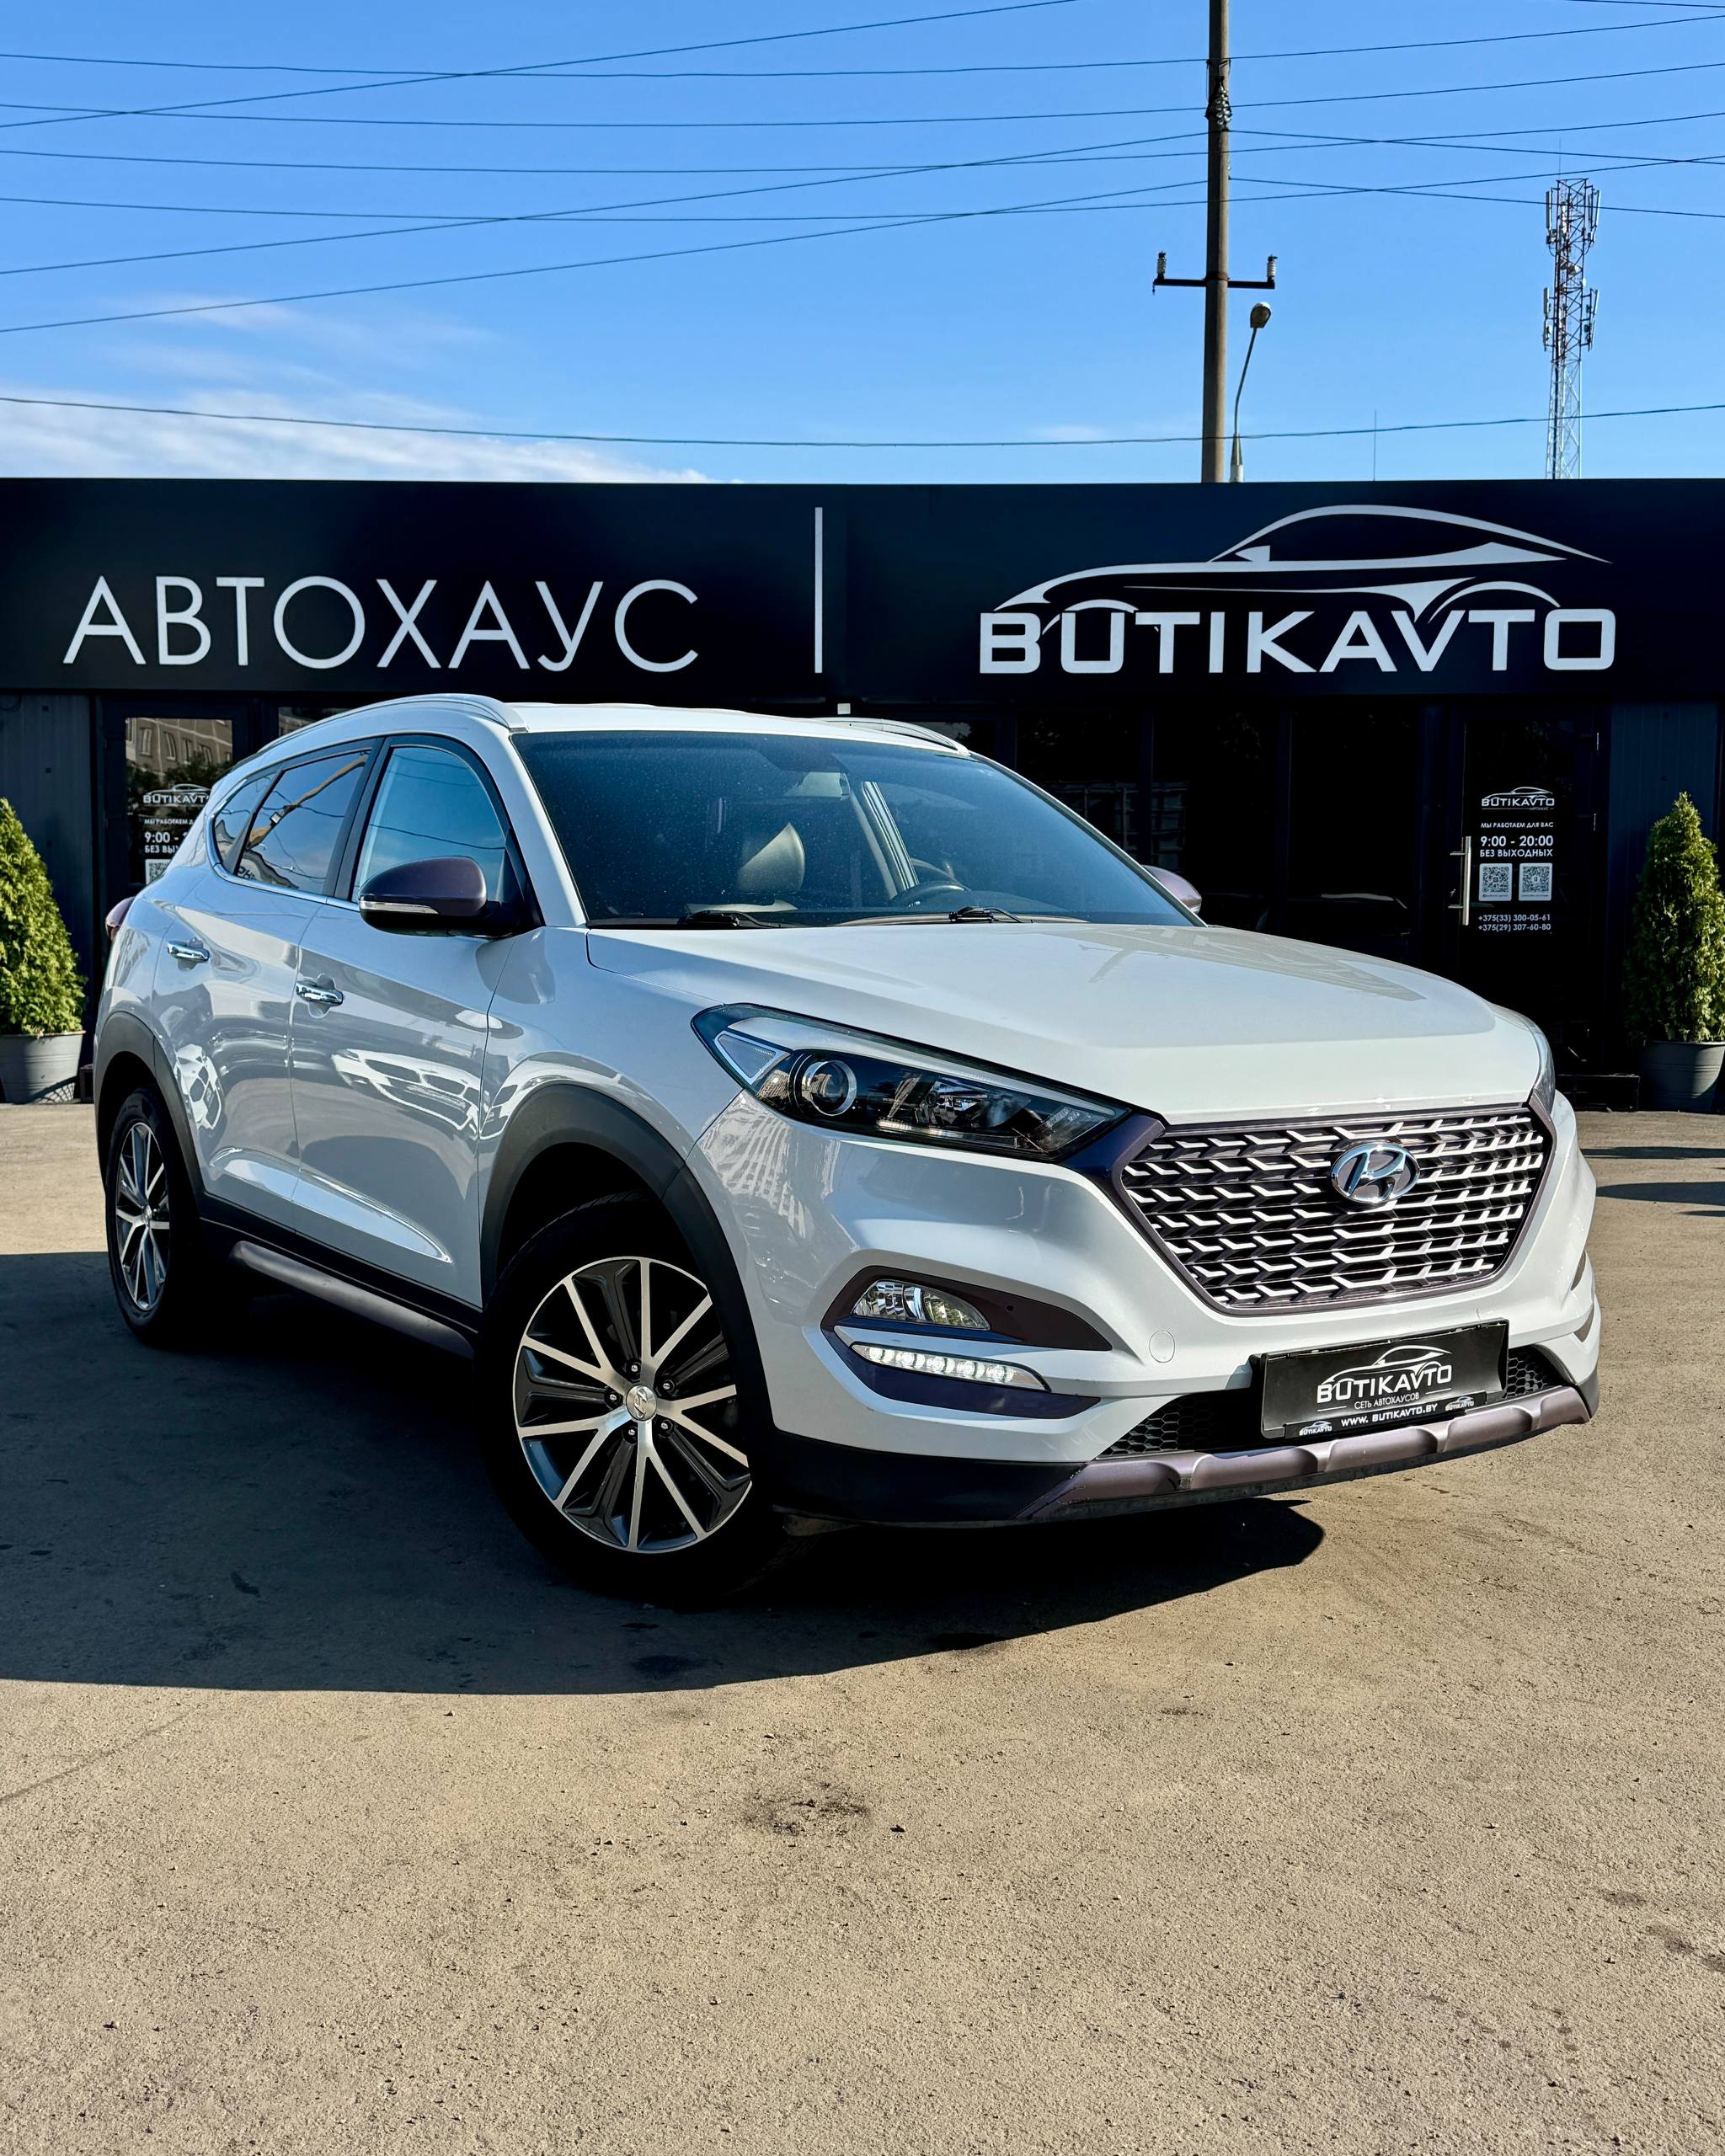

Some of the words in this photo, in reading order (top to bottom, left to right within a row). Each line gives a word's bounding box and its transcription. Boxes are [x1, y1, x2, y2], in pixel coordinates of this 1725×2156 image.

[62, 574, 700, 673] АВТОХАУС
[978, 607, 1616, 674] BUTIKAVTO
[142, 794, 209, 803] BUTIKAVT
[1482, 798, 1555, 807] BUTIKAVTO
[144, 831, 170, 843] 9:00
[1480, 835, 1507, 847] 9:00
[1519, 835, 1554, 846] 20:00
[144, 845, 160, 854] БЕЗ
[1480, 849, 1495, 857] БЕЗ
[1498, 848, 1553, 858] ВЫХОДНЫХ
[1478, 914, 1512, 923] +375(33)
[1478, 924, 1512, 932] +375(29)
[1513, 923, 1551, 931] 307-60-80
[1316, 1364, 1452, 1404] BUTIKAVTO
[1354, 1400, 1372, 1410] СЕТЬ
[1374, 1391, 1420, 1407] АВТОХАУСОВ
[1341, 1415, 1369, 1428] WWW.
[1372, 1402, 1439, 1423] BUTIKAVTO.BY
[1299, 1423, 1332, 1436] BUTIKAVTO
